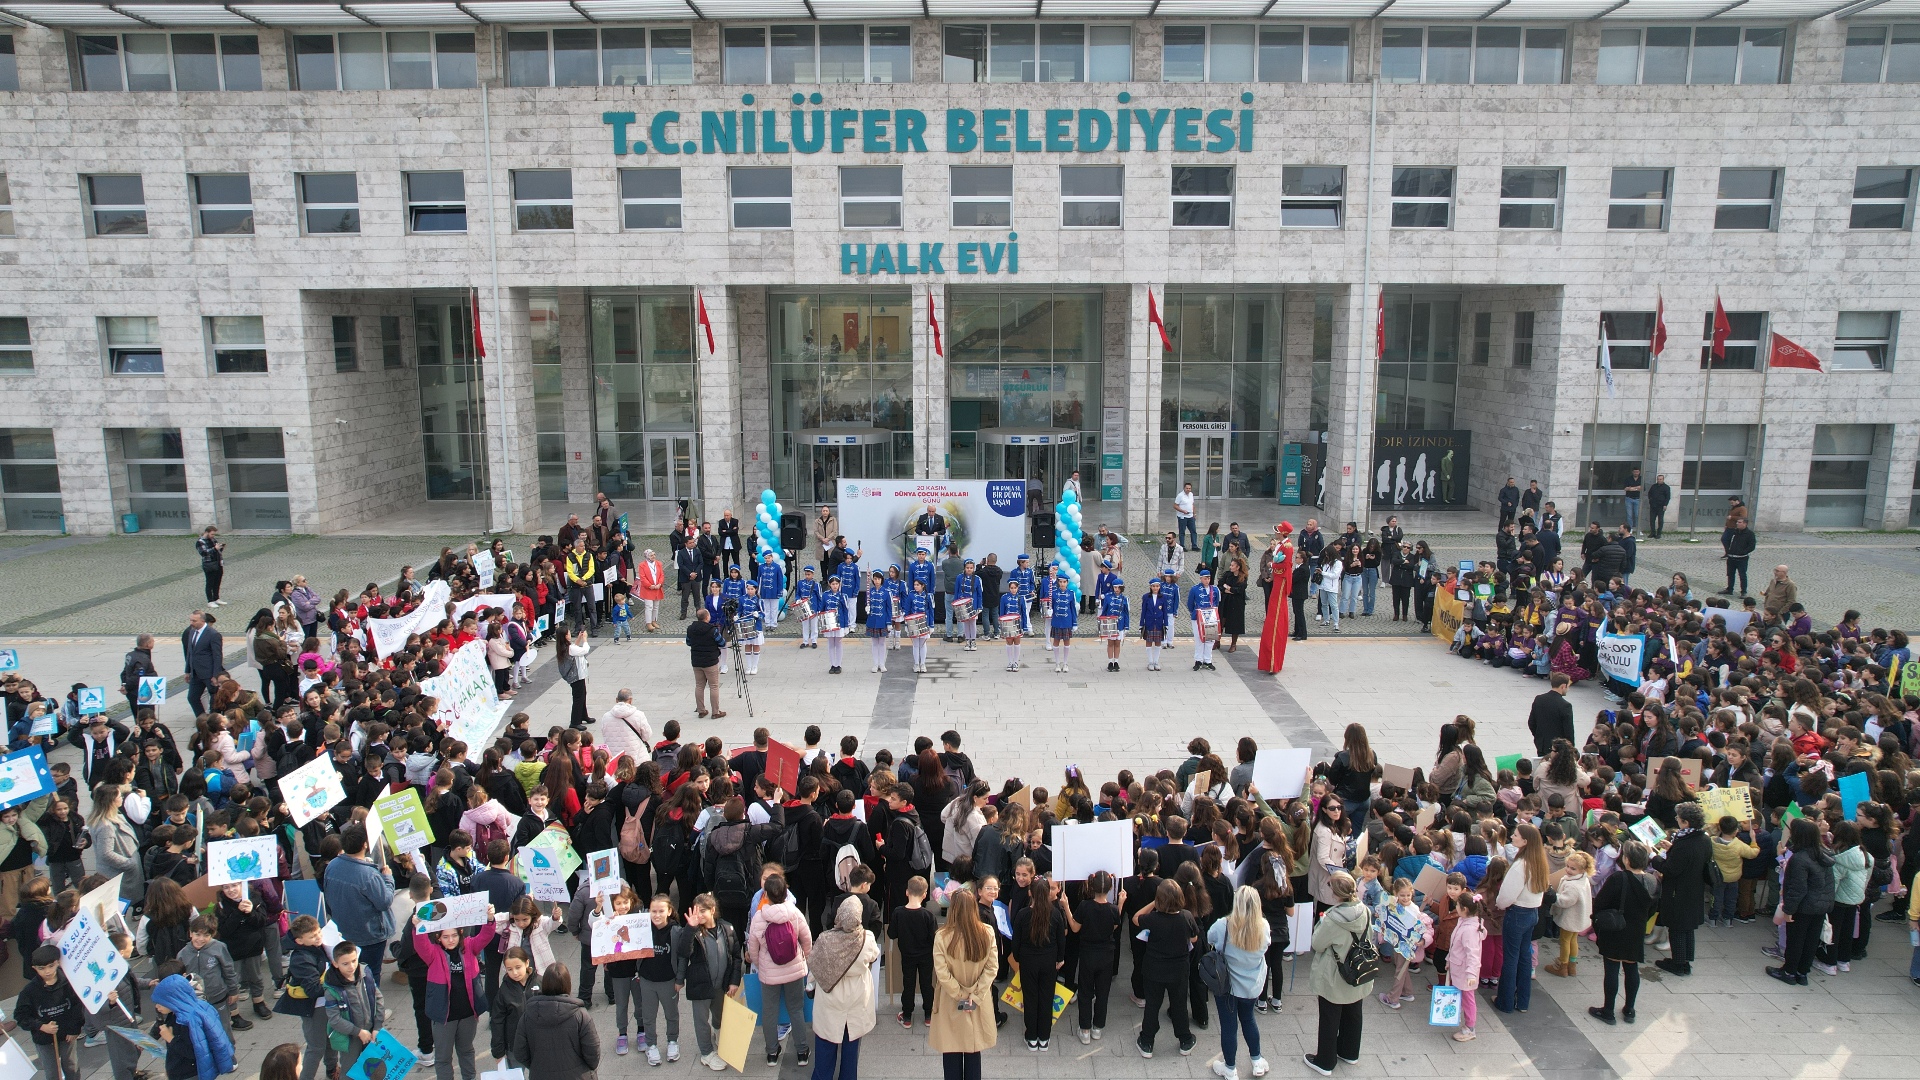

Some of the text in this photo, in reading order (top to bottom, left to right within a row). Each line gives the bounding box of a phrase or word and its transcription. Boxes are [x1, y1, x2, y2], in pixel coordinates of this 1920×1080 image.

[946, 92, 1254, 153] BELEDİYESİ
[840, 232, 1019, 275] HALK EVİ
[917, 490, 939, 498] ÇOCUK
[453, 894, 477, 905] SAVE
[70, 929, 80, 943] SU
